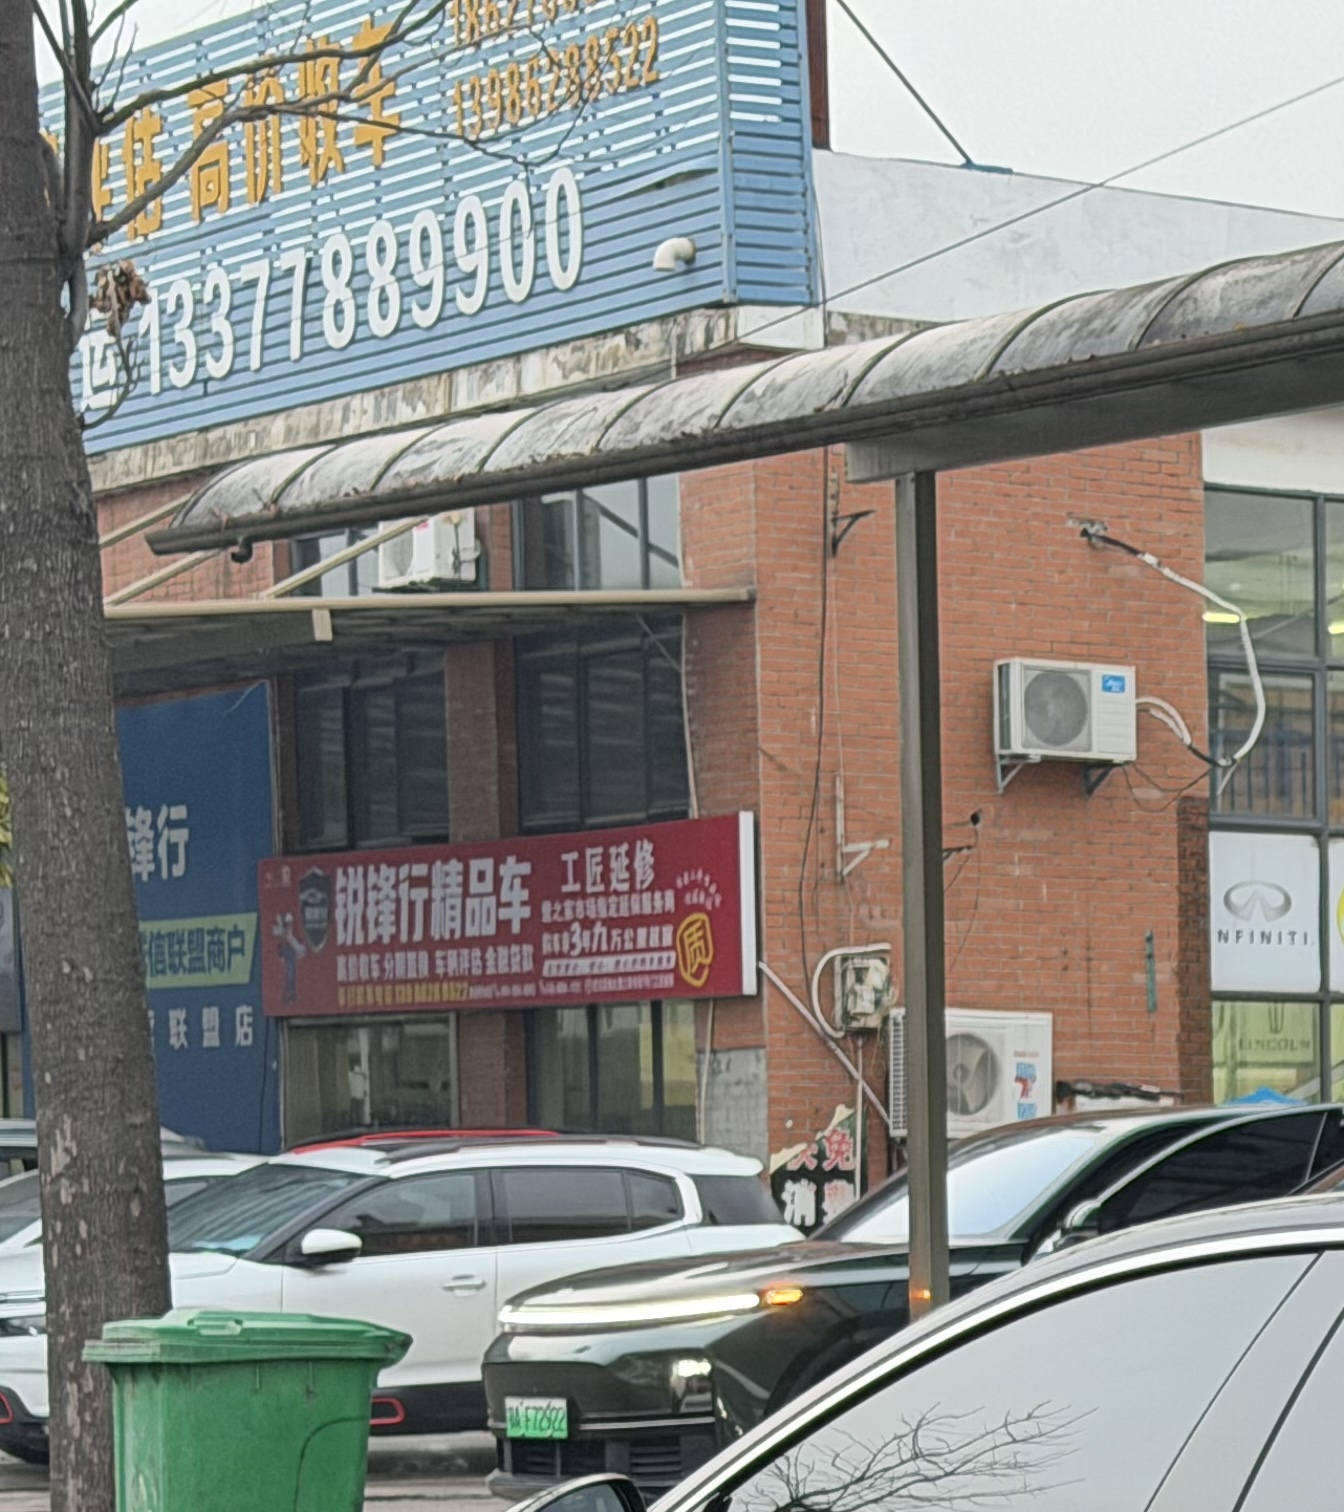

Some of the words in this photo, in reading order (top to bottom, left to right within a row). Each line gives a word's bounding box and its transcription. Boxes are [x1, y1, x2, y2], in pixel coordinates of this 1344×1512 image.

[138, 167, 582, 396] 13377889900
[335, 855, 532, 946] 锐锋行精品车
[148, 1005, 253, 1050] 联盟店
